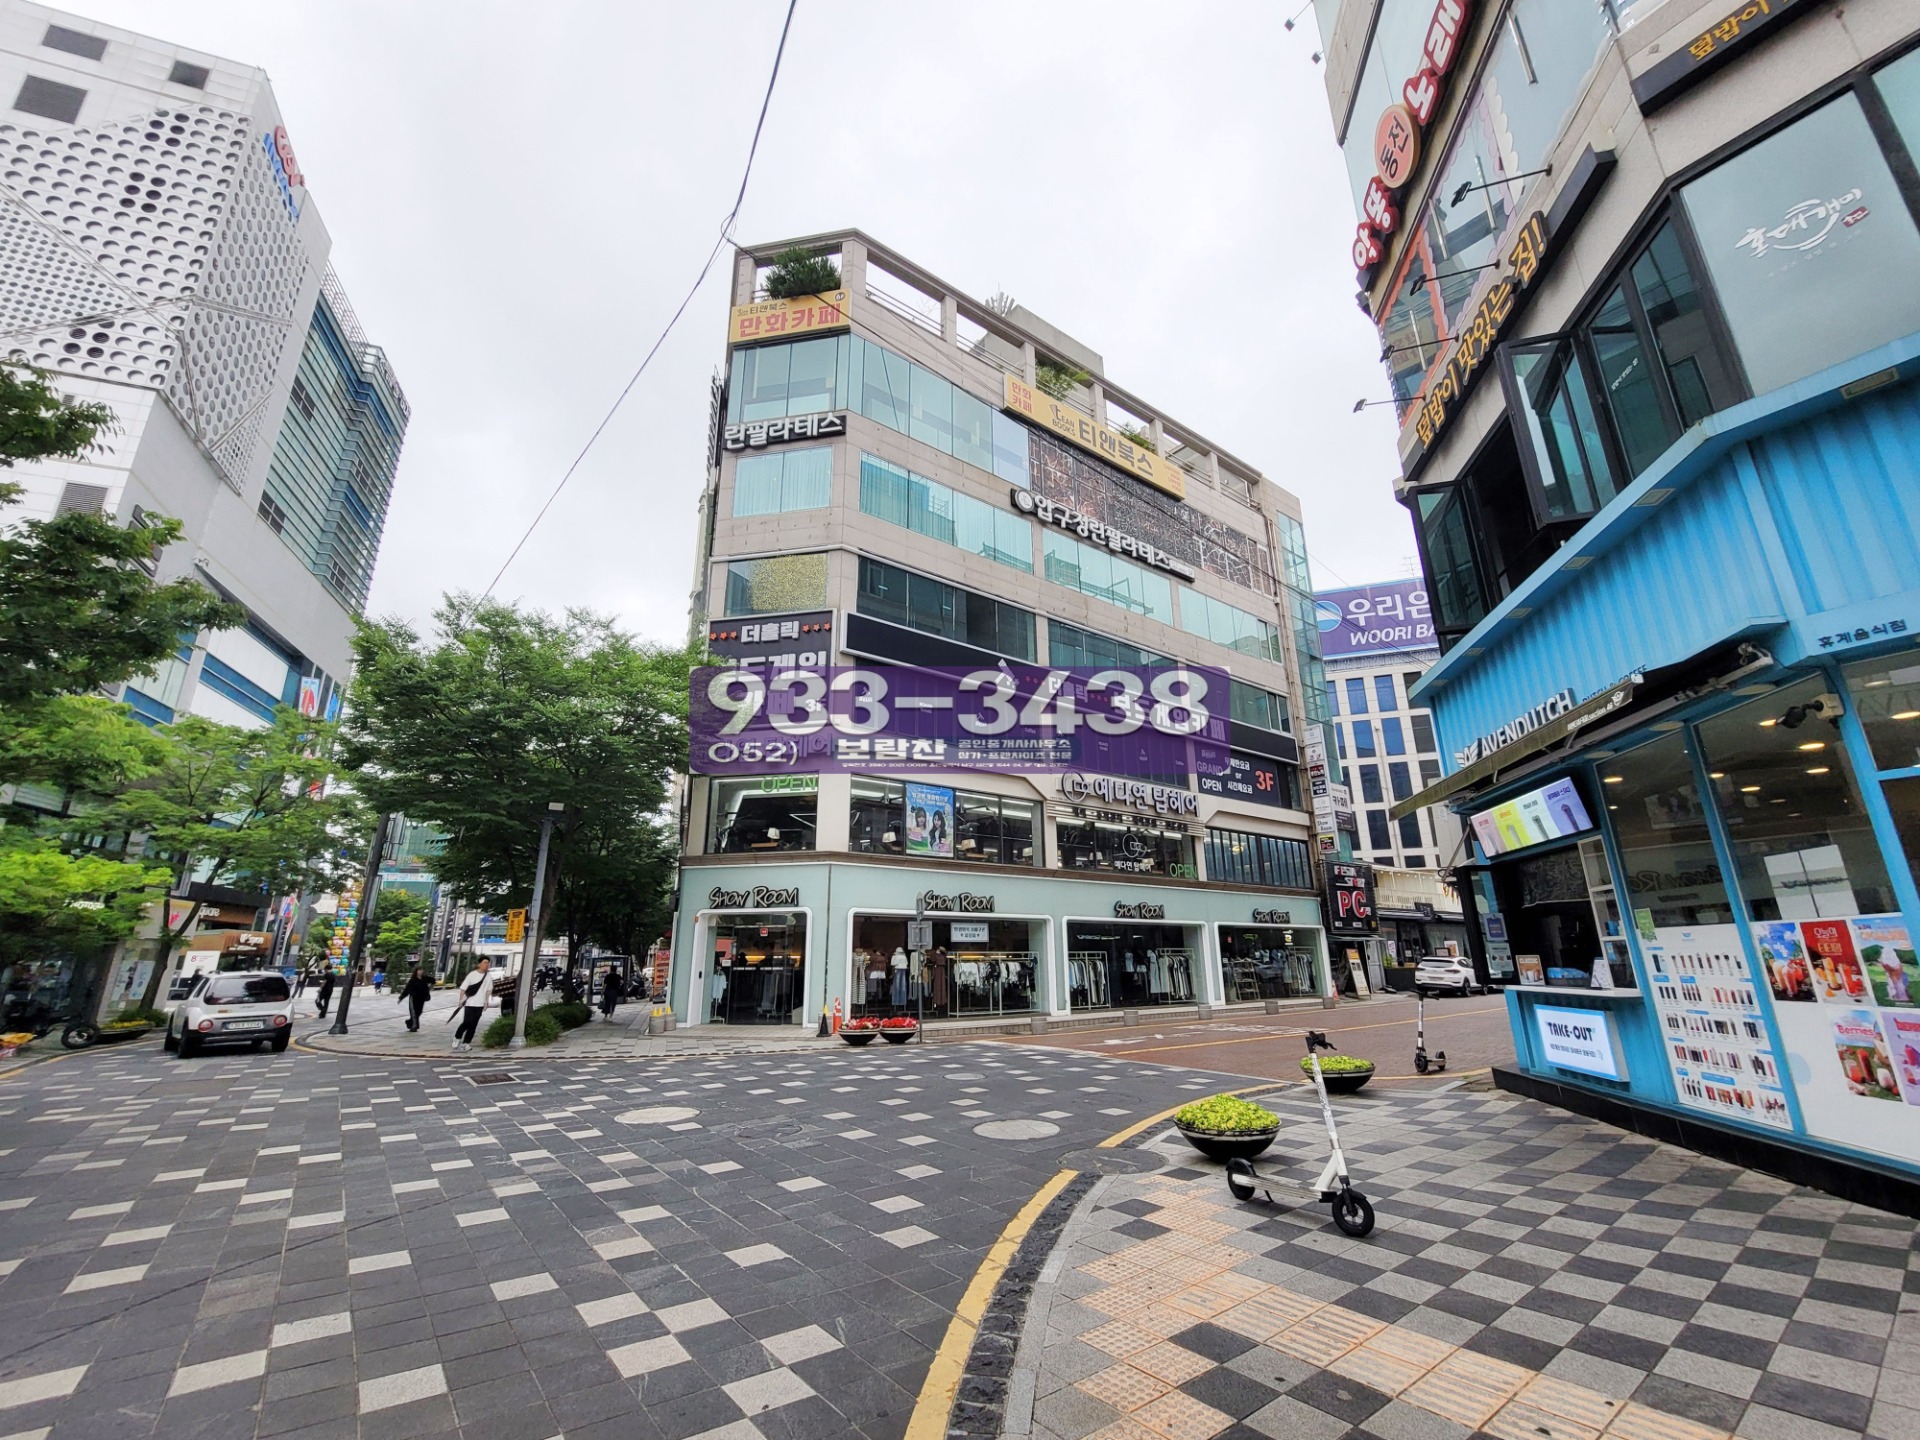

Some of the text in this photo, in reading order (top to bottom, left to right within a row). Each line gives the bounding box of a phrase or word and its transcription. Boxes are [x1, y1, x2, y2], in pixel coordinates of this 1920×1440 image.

[1688, 0, 1770, 61] 덮밥이
[1380, 115, 1409, 179] 동전
[750, 303, 787, 315] 티앤북스
[739, 303, 842, 338] 만화카페
[1416, 217, 1544, 448] 덮밥이 맛있는 집!
[1011, 381, 1032, 401] 만화
[1012, 395, 1033, 414] 카페
[724, 413, 843, 450] 린필라테스
[1052, 419, 1076, 437] BOOKS
[1078, 418, 1154, 477] 티앤북스
[1034, 494, 1173, 570] 압구정린필라테스
[1347, 590, 1431, 627] 우리은
[740, 620, 799, 643] 더홀릭
[1350, 624, 1412, 646] WOORI
[1818, 619, 1908, 649] 휴게음식점
[1481, 687, 1574, 759] AVENDUTCH
[1197, 761, 1223, 777] GRAND
[761, 774, 818, 794] OPEN
[1201, 777, 1223, 792] OPEN
[1255, 770, 1275, 792] 3F
[1093, 777, 1201, 817] 예다연 탑헤어
[1169, 862, 1198, 878] OPEN
[1813, 926, 1839, 939] 오늘의
[1547, 1021, 1593, 1042] TAKE-OUT
